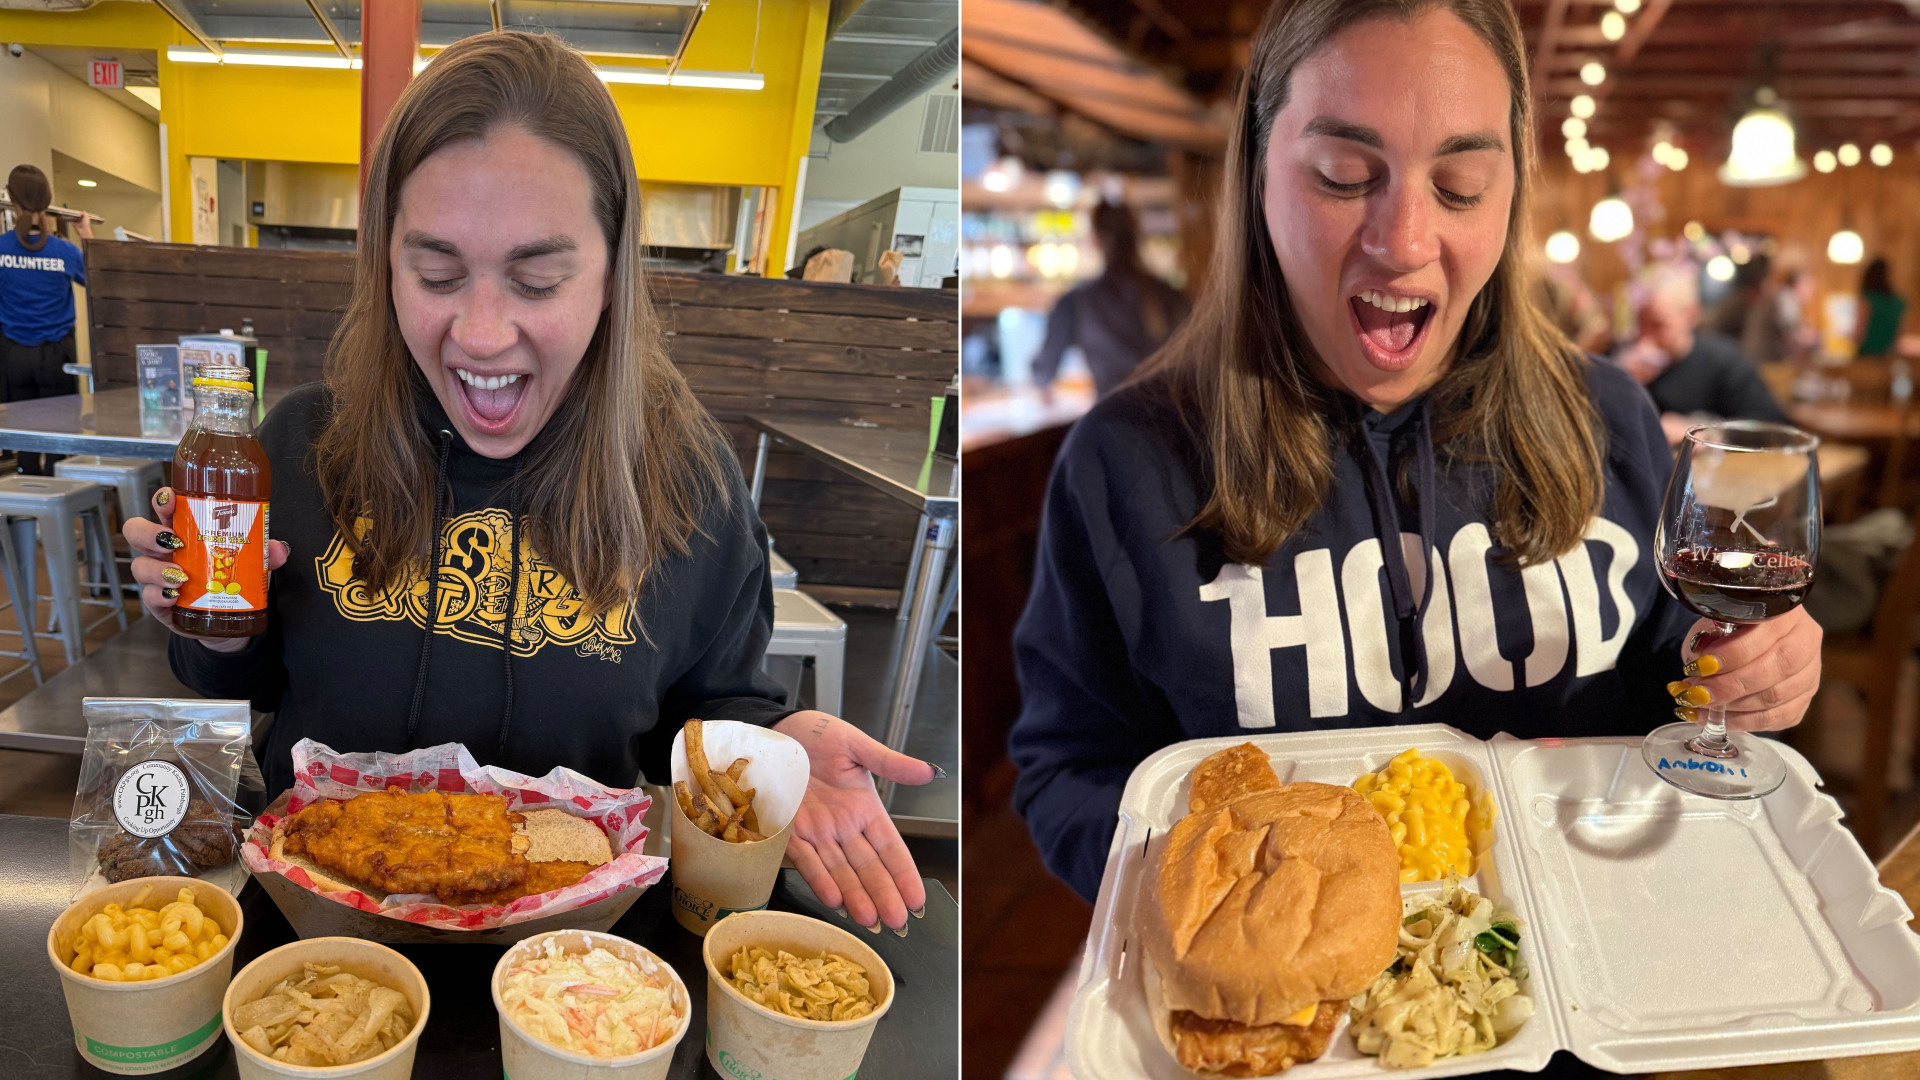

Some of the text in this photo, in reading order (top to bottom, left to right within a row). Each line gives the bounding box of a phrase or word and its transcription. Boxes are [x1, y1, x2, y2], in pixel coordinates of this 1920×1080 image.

[94, 62, 118, 86] EXIT
[0, 254, 65, 272] VOLUNTEER
[197, 535, 226, 543] ICED
[204, 530, 244, 538] PREMIUM
[1751, 551, 1806, 568] Cellar
[1199, 516, 1640, 728] HOOD
[142, 763, 172, 772] Community
[171, 770, 184, 788] Kitchen
[117, 769, 140, 809] www.CKPgh.org
[123, 816, 141, 833] Cooking
[149, 818, 176, 834] Opportunity
[675, 886, 712, 921] CHOICE
[688, 893, 713, 909] ECO
[94, 1045, 177, 1059] COMPOSTABLE
[125, 1064, 159, 1072] CONTENTS
[718, 1050, 757, 1080] CHOIC
